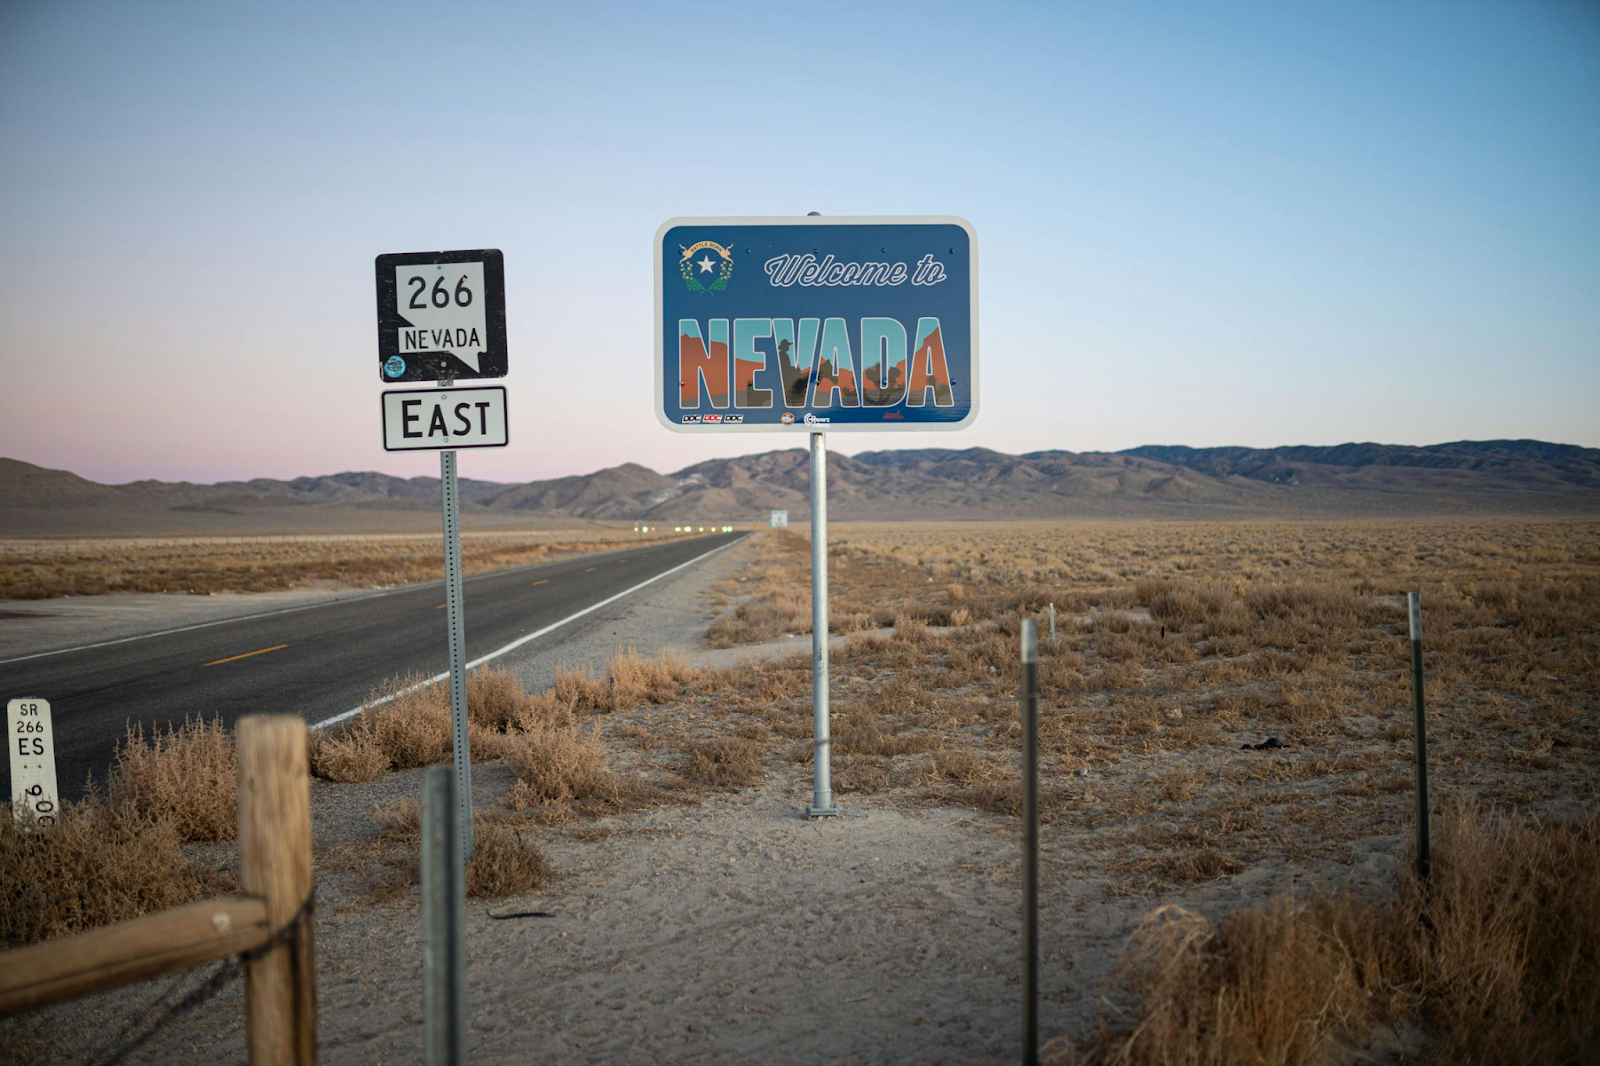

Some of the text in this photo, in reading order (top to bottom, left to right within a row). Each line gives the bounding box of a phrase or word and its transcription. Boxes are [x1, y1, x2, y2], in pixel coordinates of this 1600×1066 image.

[691, 242, 723, 252] BATTLE BORN
[764, 254, 947, 287] Welcome to
[407, 274, 473, 309] 266
[405, 327, 480, 350] NEVADA
[678, 316, 954, 409] NEVADA
[402, 399, 490, 438] EAST
[20, 703, 38, 716] SR
[17, 721, 44, 733] 266
[18, 737, 44, 755] ES
